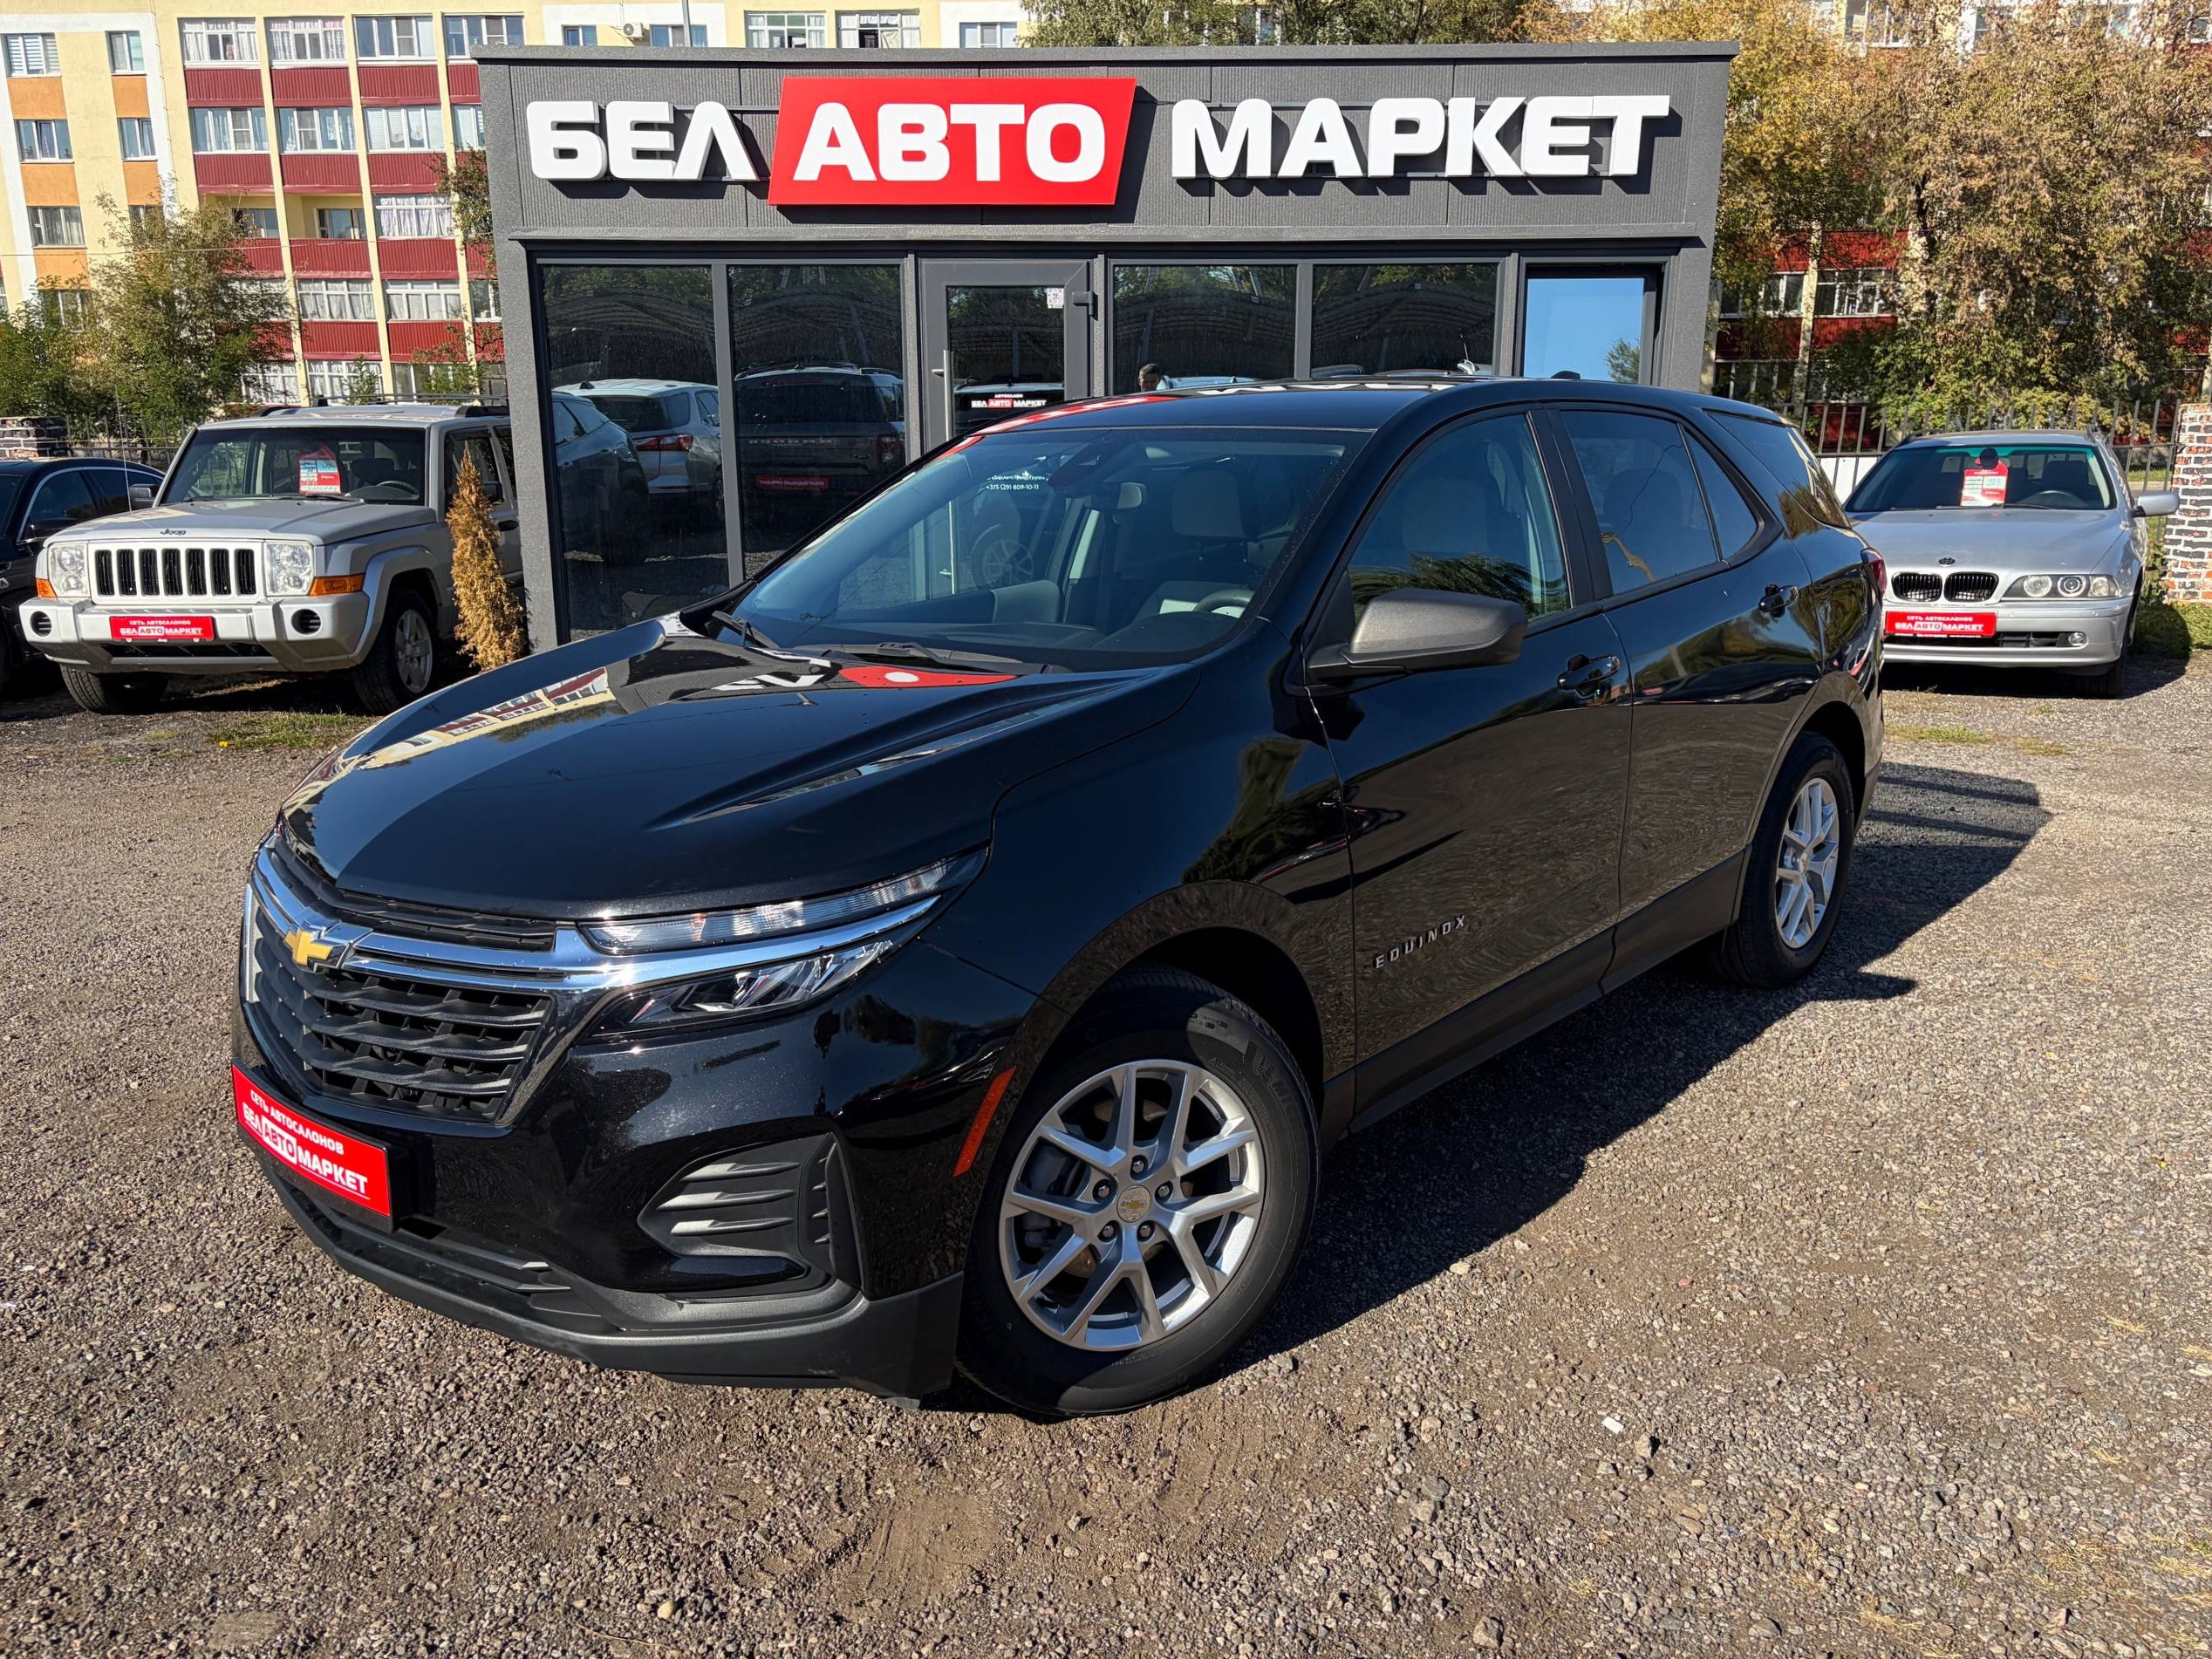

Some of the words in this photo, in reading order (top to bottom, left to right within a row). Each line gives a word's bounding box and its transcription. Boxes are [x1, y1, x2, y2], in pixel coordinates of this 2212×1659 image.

[525, 100, 760, 181] БЕЛ
[793, 102, 1106, 182] АВТО
[1171, 95, 1670, 179] МАРКЕТ
[1014, 399, 1047, 408] МАРКЕТ
[119, 627, 138, 636] БЕЛ
[165, 627, 203, 636] МАРКЕТ
[1895, 622, 1914, 631] БЕЛ
[1942, 624, 1984, 632] МАРКЕТ
[1374, 913, 1466, 970] EQUINOX
[242, 1102, 263, 1135] БЕЛ
[263, 1121, 297, 1159] АВТО
[297, 1144, 369, 1195] МАРКЕТ
[249, 1089, 270, 1114] СЕТЬ
[270, 1106, 345, 1156] АВТОСАЛОНОВ
